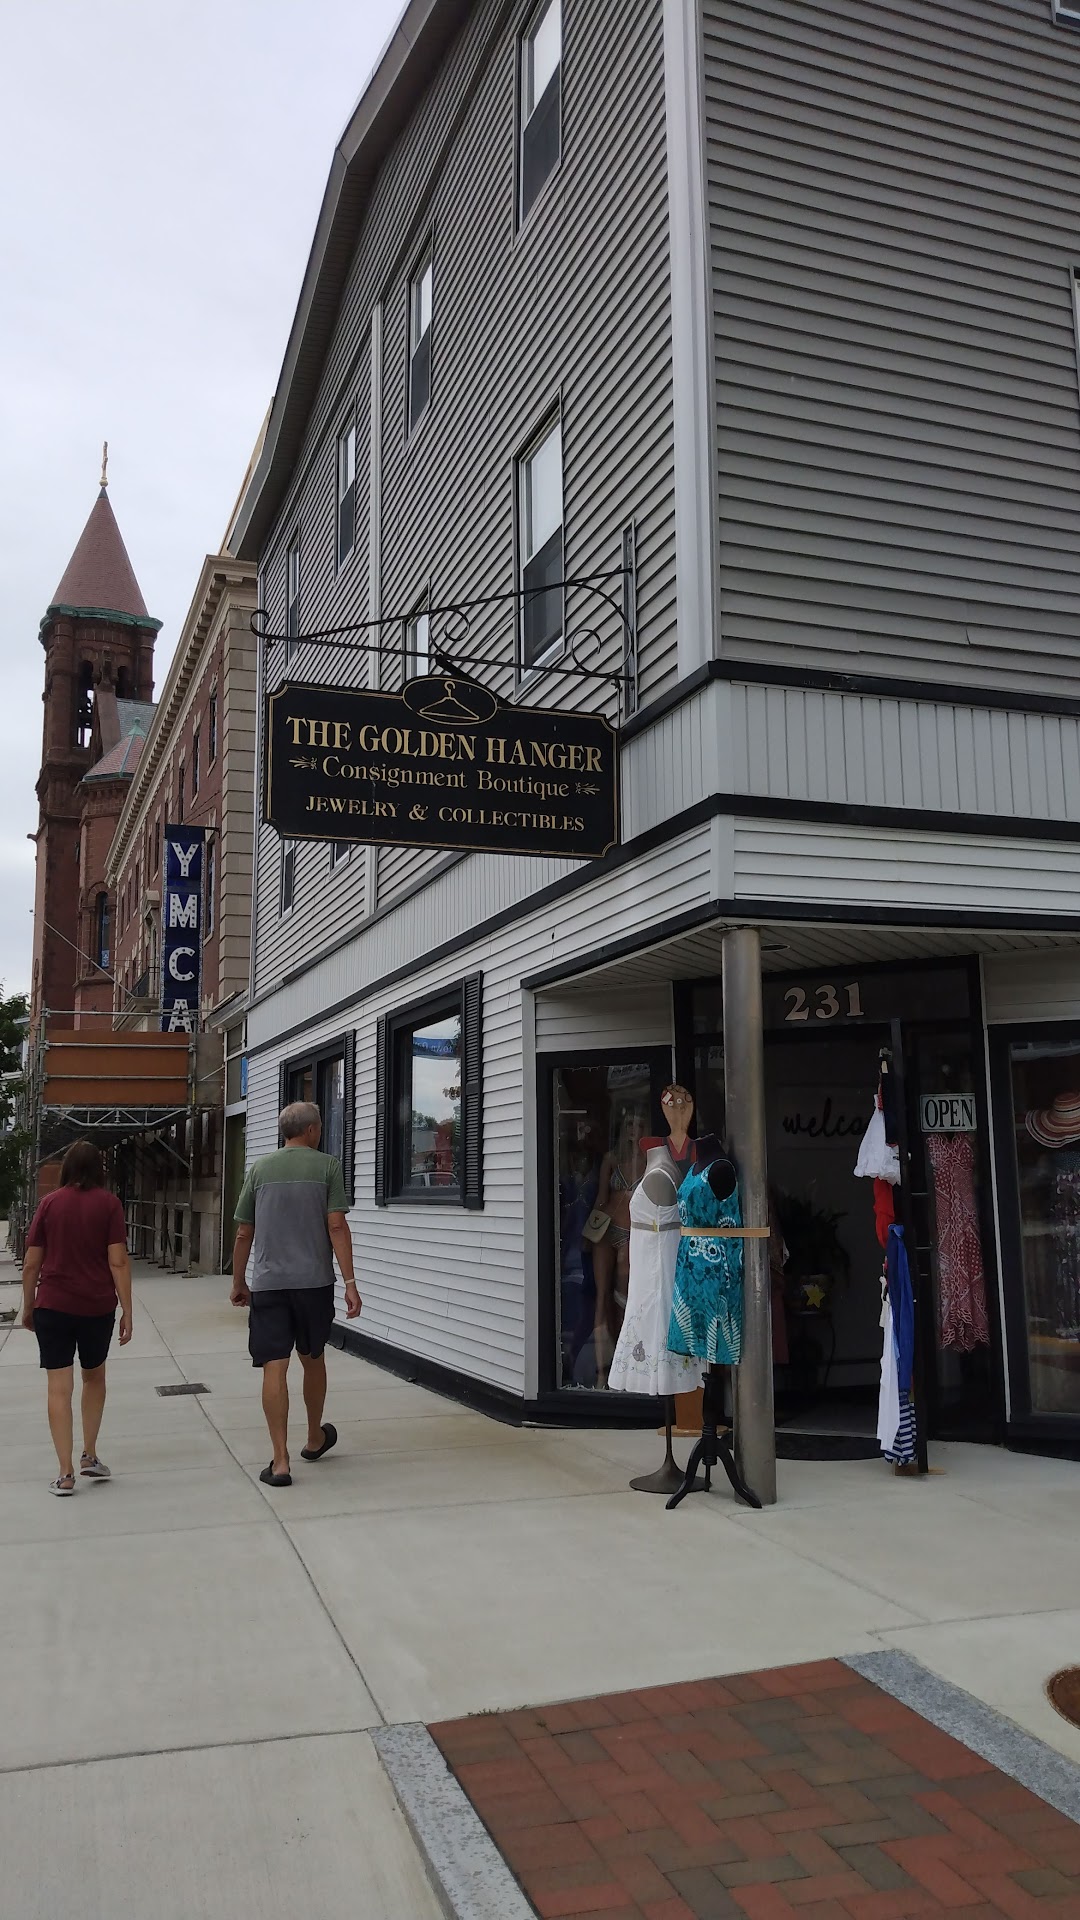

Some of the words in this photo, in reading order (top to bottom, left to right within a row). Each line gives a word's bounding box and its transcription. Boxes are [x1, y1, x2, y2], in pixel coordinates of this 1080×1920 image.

[285, 716, 352, 751] THE
[358, 724, 478, 761] GOLDEN
[486, 737, 603, 773] HANGER
[322, 755, 468, 788] Consignment
[478, 770, 570, 800] Boutique
[305, 796, 400, 818] JEWELRY
[408, 803, 429, 821] &
[438, 806, 585, 831] COLLECTIBLES
[168, 842, 199, 1033] YMCA
[784, 982, 864, 1021] 231
[782, 1097, 870, 1138] welco
[924, 1099, 974, 1128] OPEN
